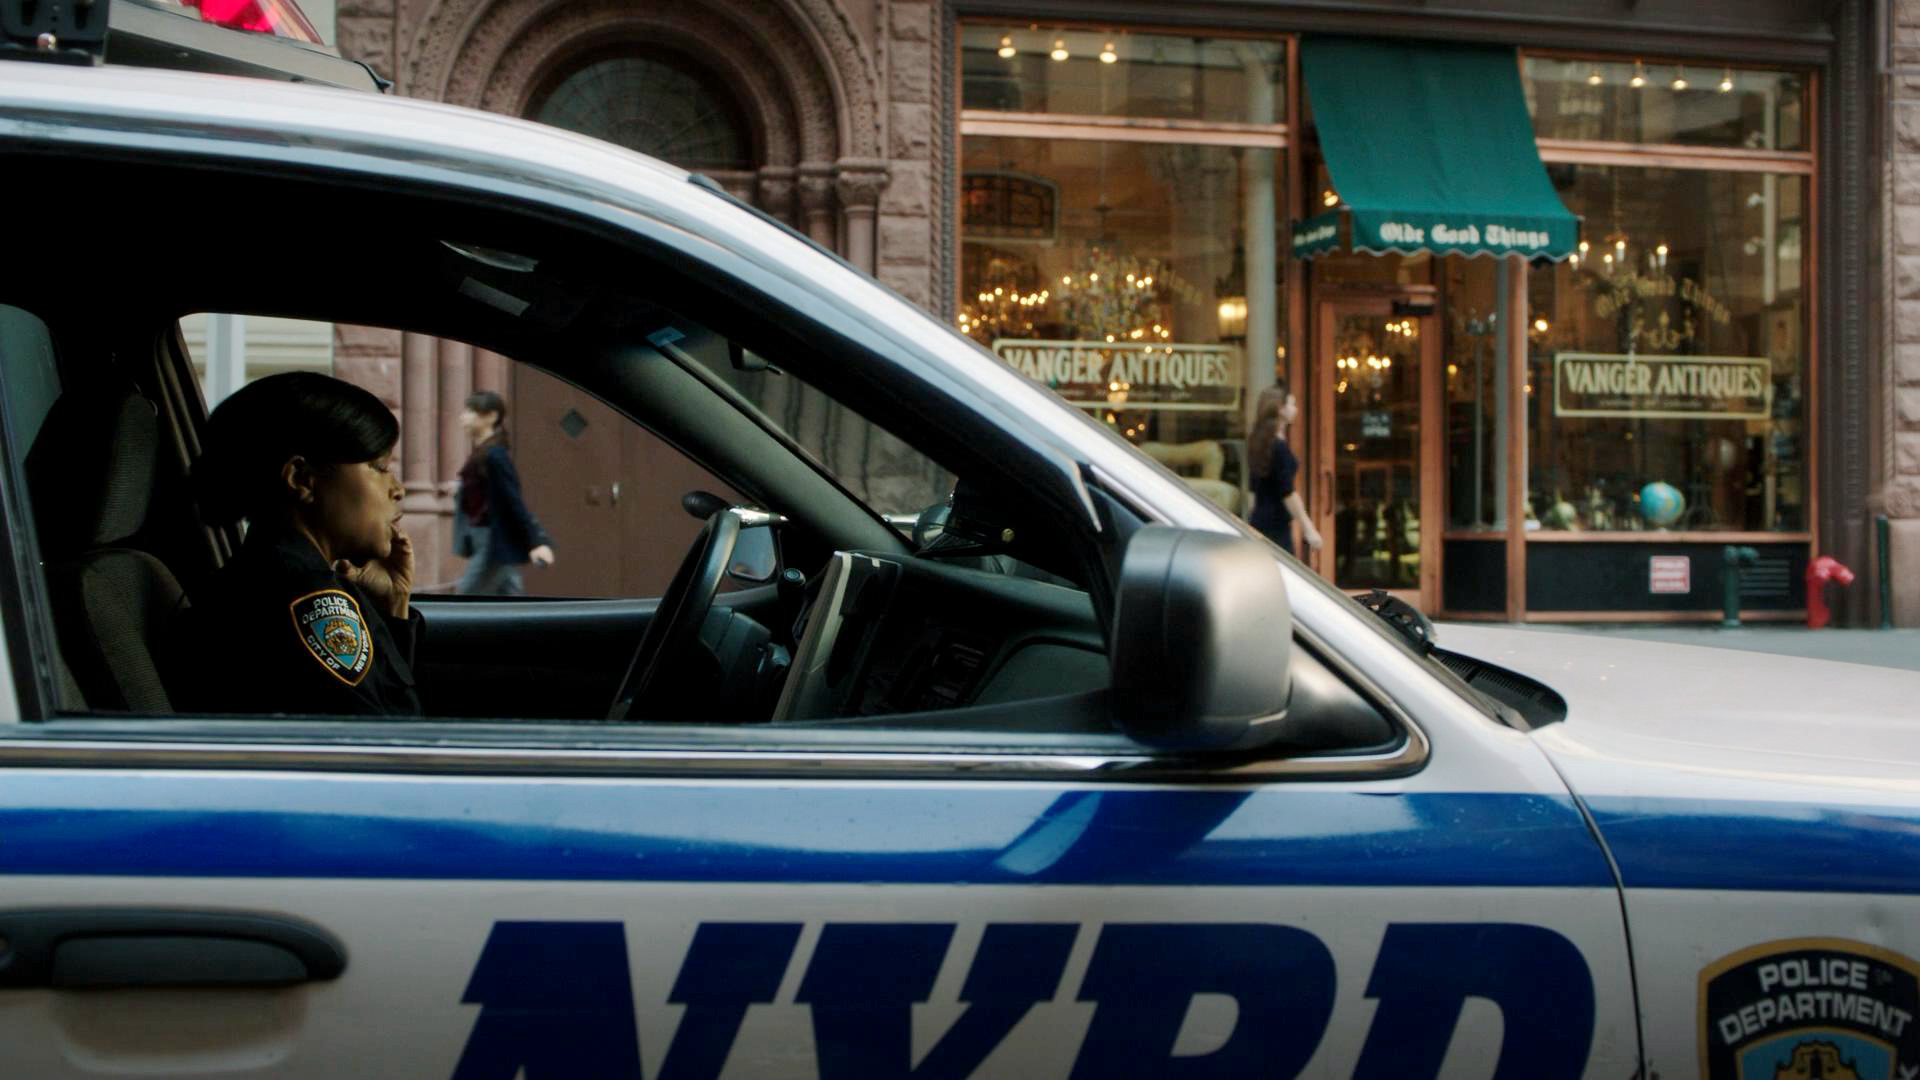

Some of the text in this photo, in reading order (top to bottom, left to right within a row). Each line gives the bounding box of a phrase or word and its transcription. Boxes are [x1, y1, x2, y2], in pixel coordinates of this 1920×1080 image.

[1379, 221, 1550, 249] Olde Good Things
[1107, 351, 1230, 388] ANTIQUES
[1564, 361, 1762, 398] VANGER ANTIQUES
[313, 596, 349, 609] POLICE
[1757, 957, 1870, 993] POLICE
[1718, 991, 1913, 1045] DEPARTMENT
